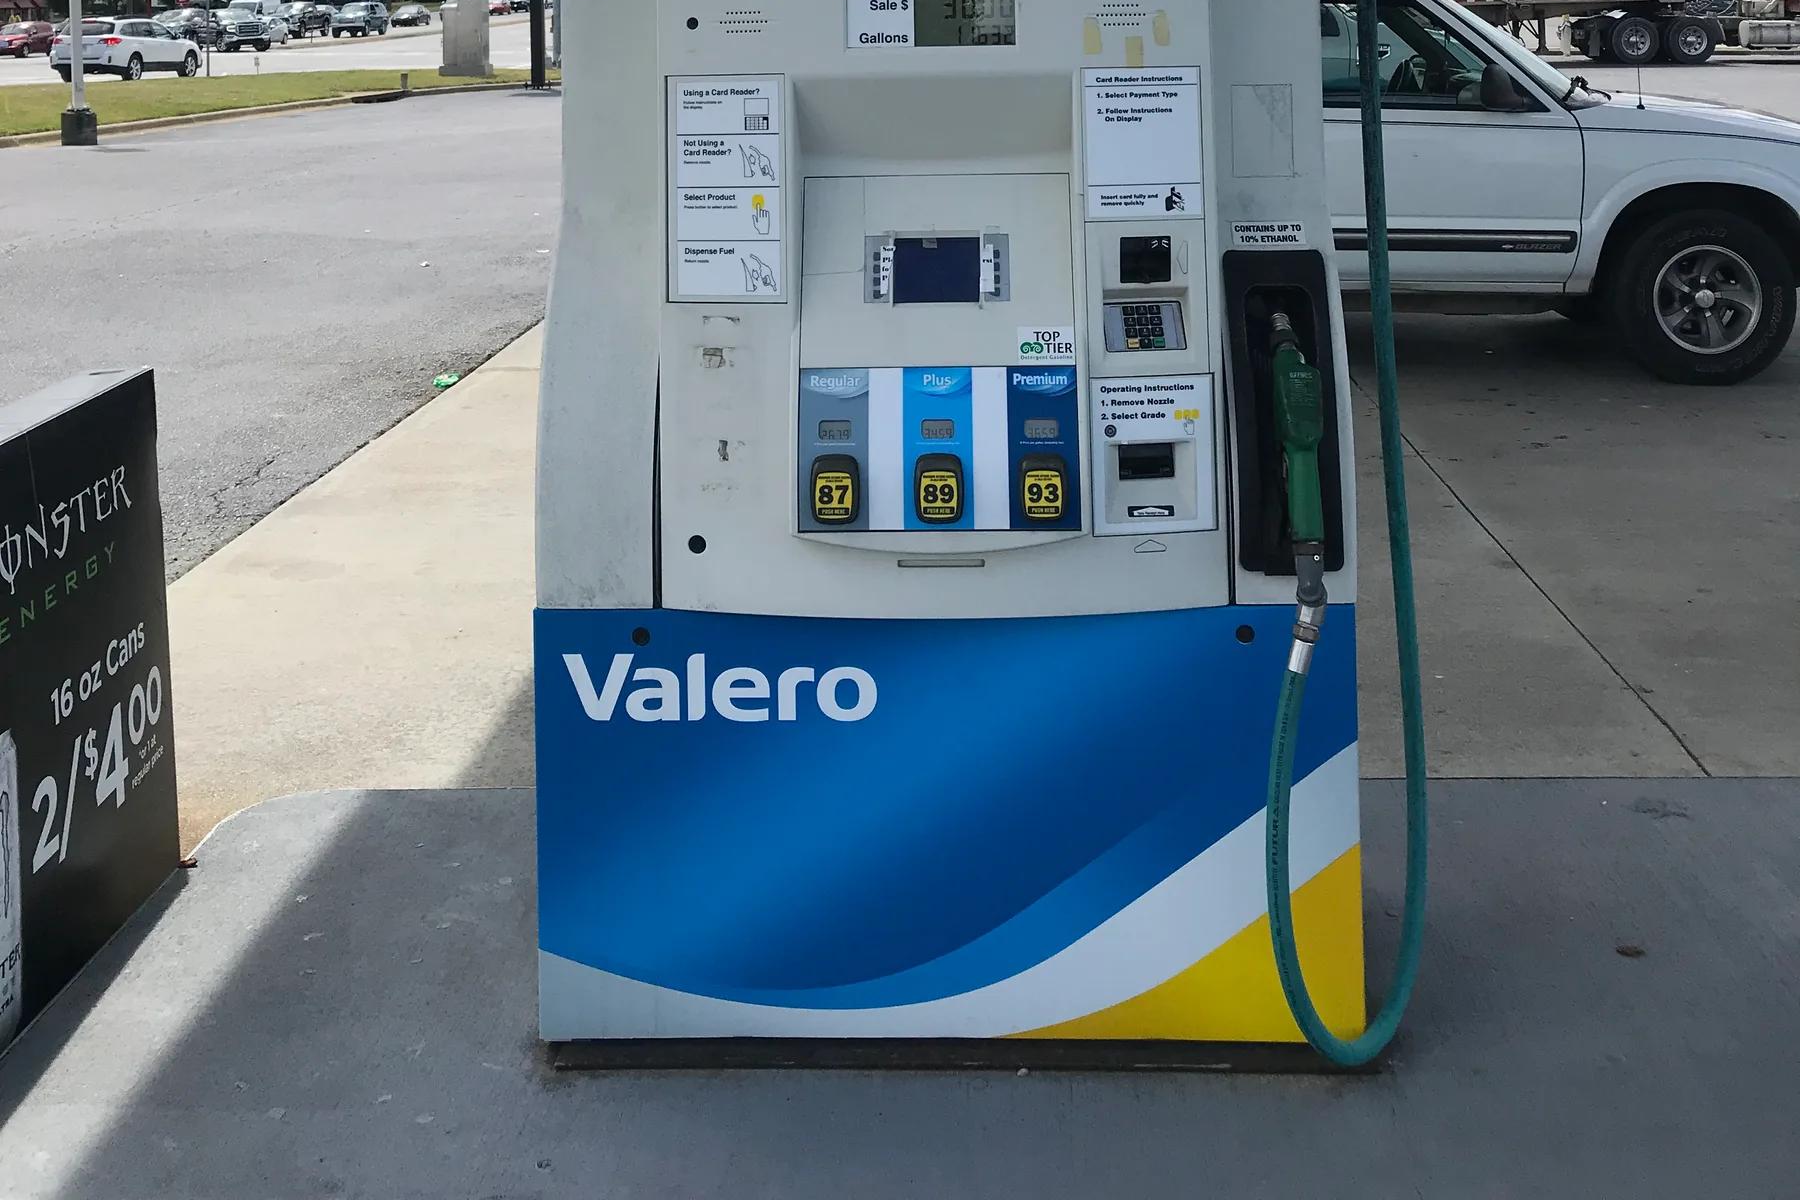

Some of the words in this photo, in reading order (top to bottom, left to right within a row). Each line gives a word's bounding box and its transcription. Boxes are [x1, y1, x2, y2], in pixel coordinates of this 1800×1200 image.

[869, 0, 897, 11] Sale
[901, 0, 909, 11] $
[859, 33, 909, 44] Gallons
[683, 89, 704, 97] Using
[711, 88, 728, 96] Card
[730, 88, 760, 96] Reader?
[697, 140, 719, 148] Using
[702, 148, 731, 156] Reader?
[707, 193, 736, 201] Product
[1234, 224, 1276, 232] CONTAINS
[1277, 224, 1289, 232] UP
[1290, 224, 1301, 232] TO
[1240, 235, 1259, 243] 10%
[1260, 234, 1299, 243] ETHANOL
[684, 247, 718, 256] Dispense
[719, 247, 735, 255] Fuel
[1033, 331, 1060, 342] TOP
[1044, 342, 1073, 353] TIER
[810, 375, 860, 389] Regular
[923, 374, 951, 386] Plus
[1012, 372, 1068, 385] Premium
[1100, 385, 1142, 394] Operating
[1144, 383, 1195, 392] Instructions
[1111, 412, 1138, 420] Select
[1140, 411, 1166, 419] Grade
[818, 484, 849, 505] 87
[922, 483, 955, 504] 89
[1027, 483, 1060, 504] 93
[0, 541, 114, 644] ENERGY
[51, 678, 73, 725] 16
[79, 661, 102, 701] oz
[106, 622, 145, 675] Cans
[561, 653, 878, 722] Valero
